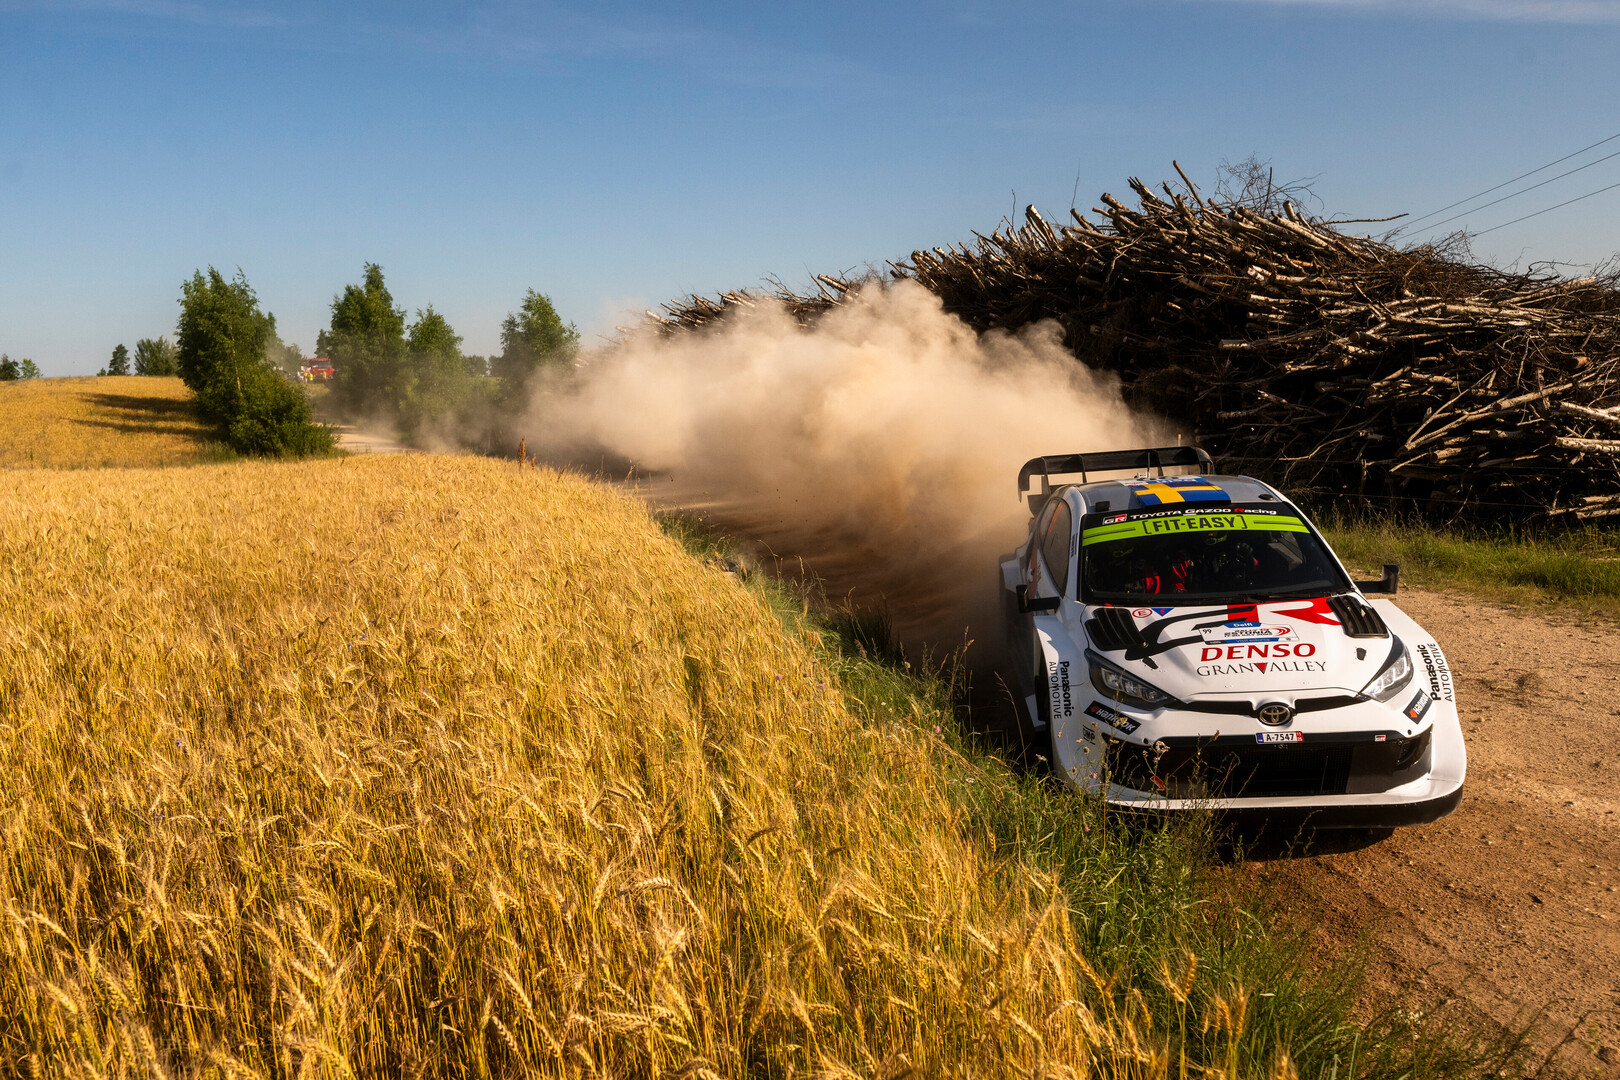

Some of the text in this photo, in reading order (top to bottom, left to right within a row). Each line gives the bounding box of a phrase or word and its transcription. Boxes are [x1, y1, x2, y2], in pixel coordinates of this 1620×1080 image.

[1130, 510, 1182, 520] TOYOTA
[1234, 507, 1277, 515] Racing
[1197, 661, 1327, 677] GRANVALLEY
[1201, 643, 1316, 662] DENSO
[1049, 661, 1062, 719] AUTOMOTIVE
[1060, 661, 1075, 717] Panasonic
[1417, 644, 1442, 701] Panasonic
[1427, 643, 1453, 702] AUTOMOTIVE
[1266, 732, 1295, 742] A-7547
